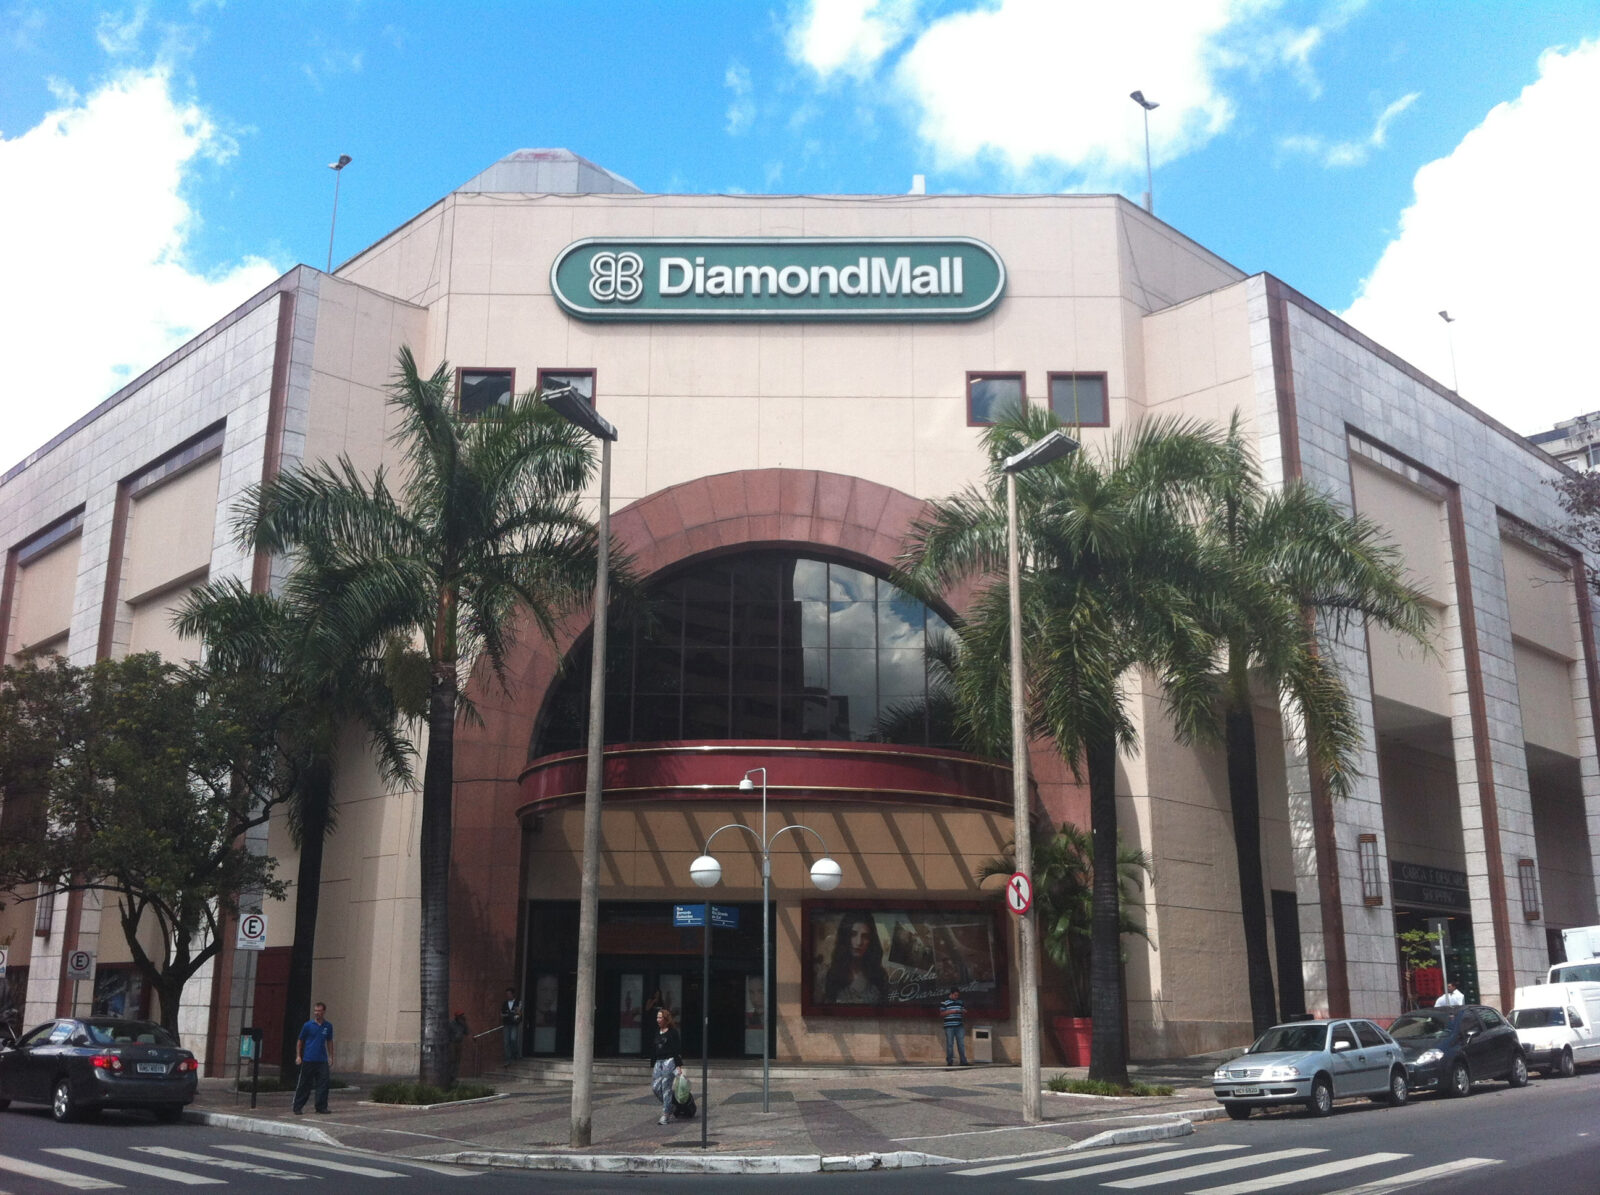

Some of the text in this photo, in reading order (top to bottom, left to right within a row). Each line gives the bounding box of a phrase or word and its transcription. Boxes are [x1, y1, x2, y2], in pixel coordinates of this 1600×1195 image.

[659, 256, 964, 296] DiamondMall
[248, 919, 258, 934] E
[76, 954, 85, 967] E
[888, 964, 938, 985] Moda
